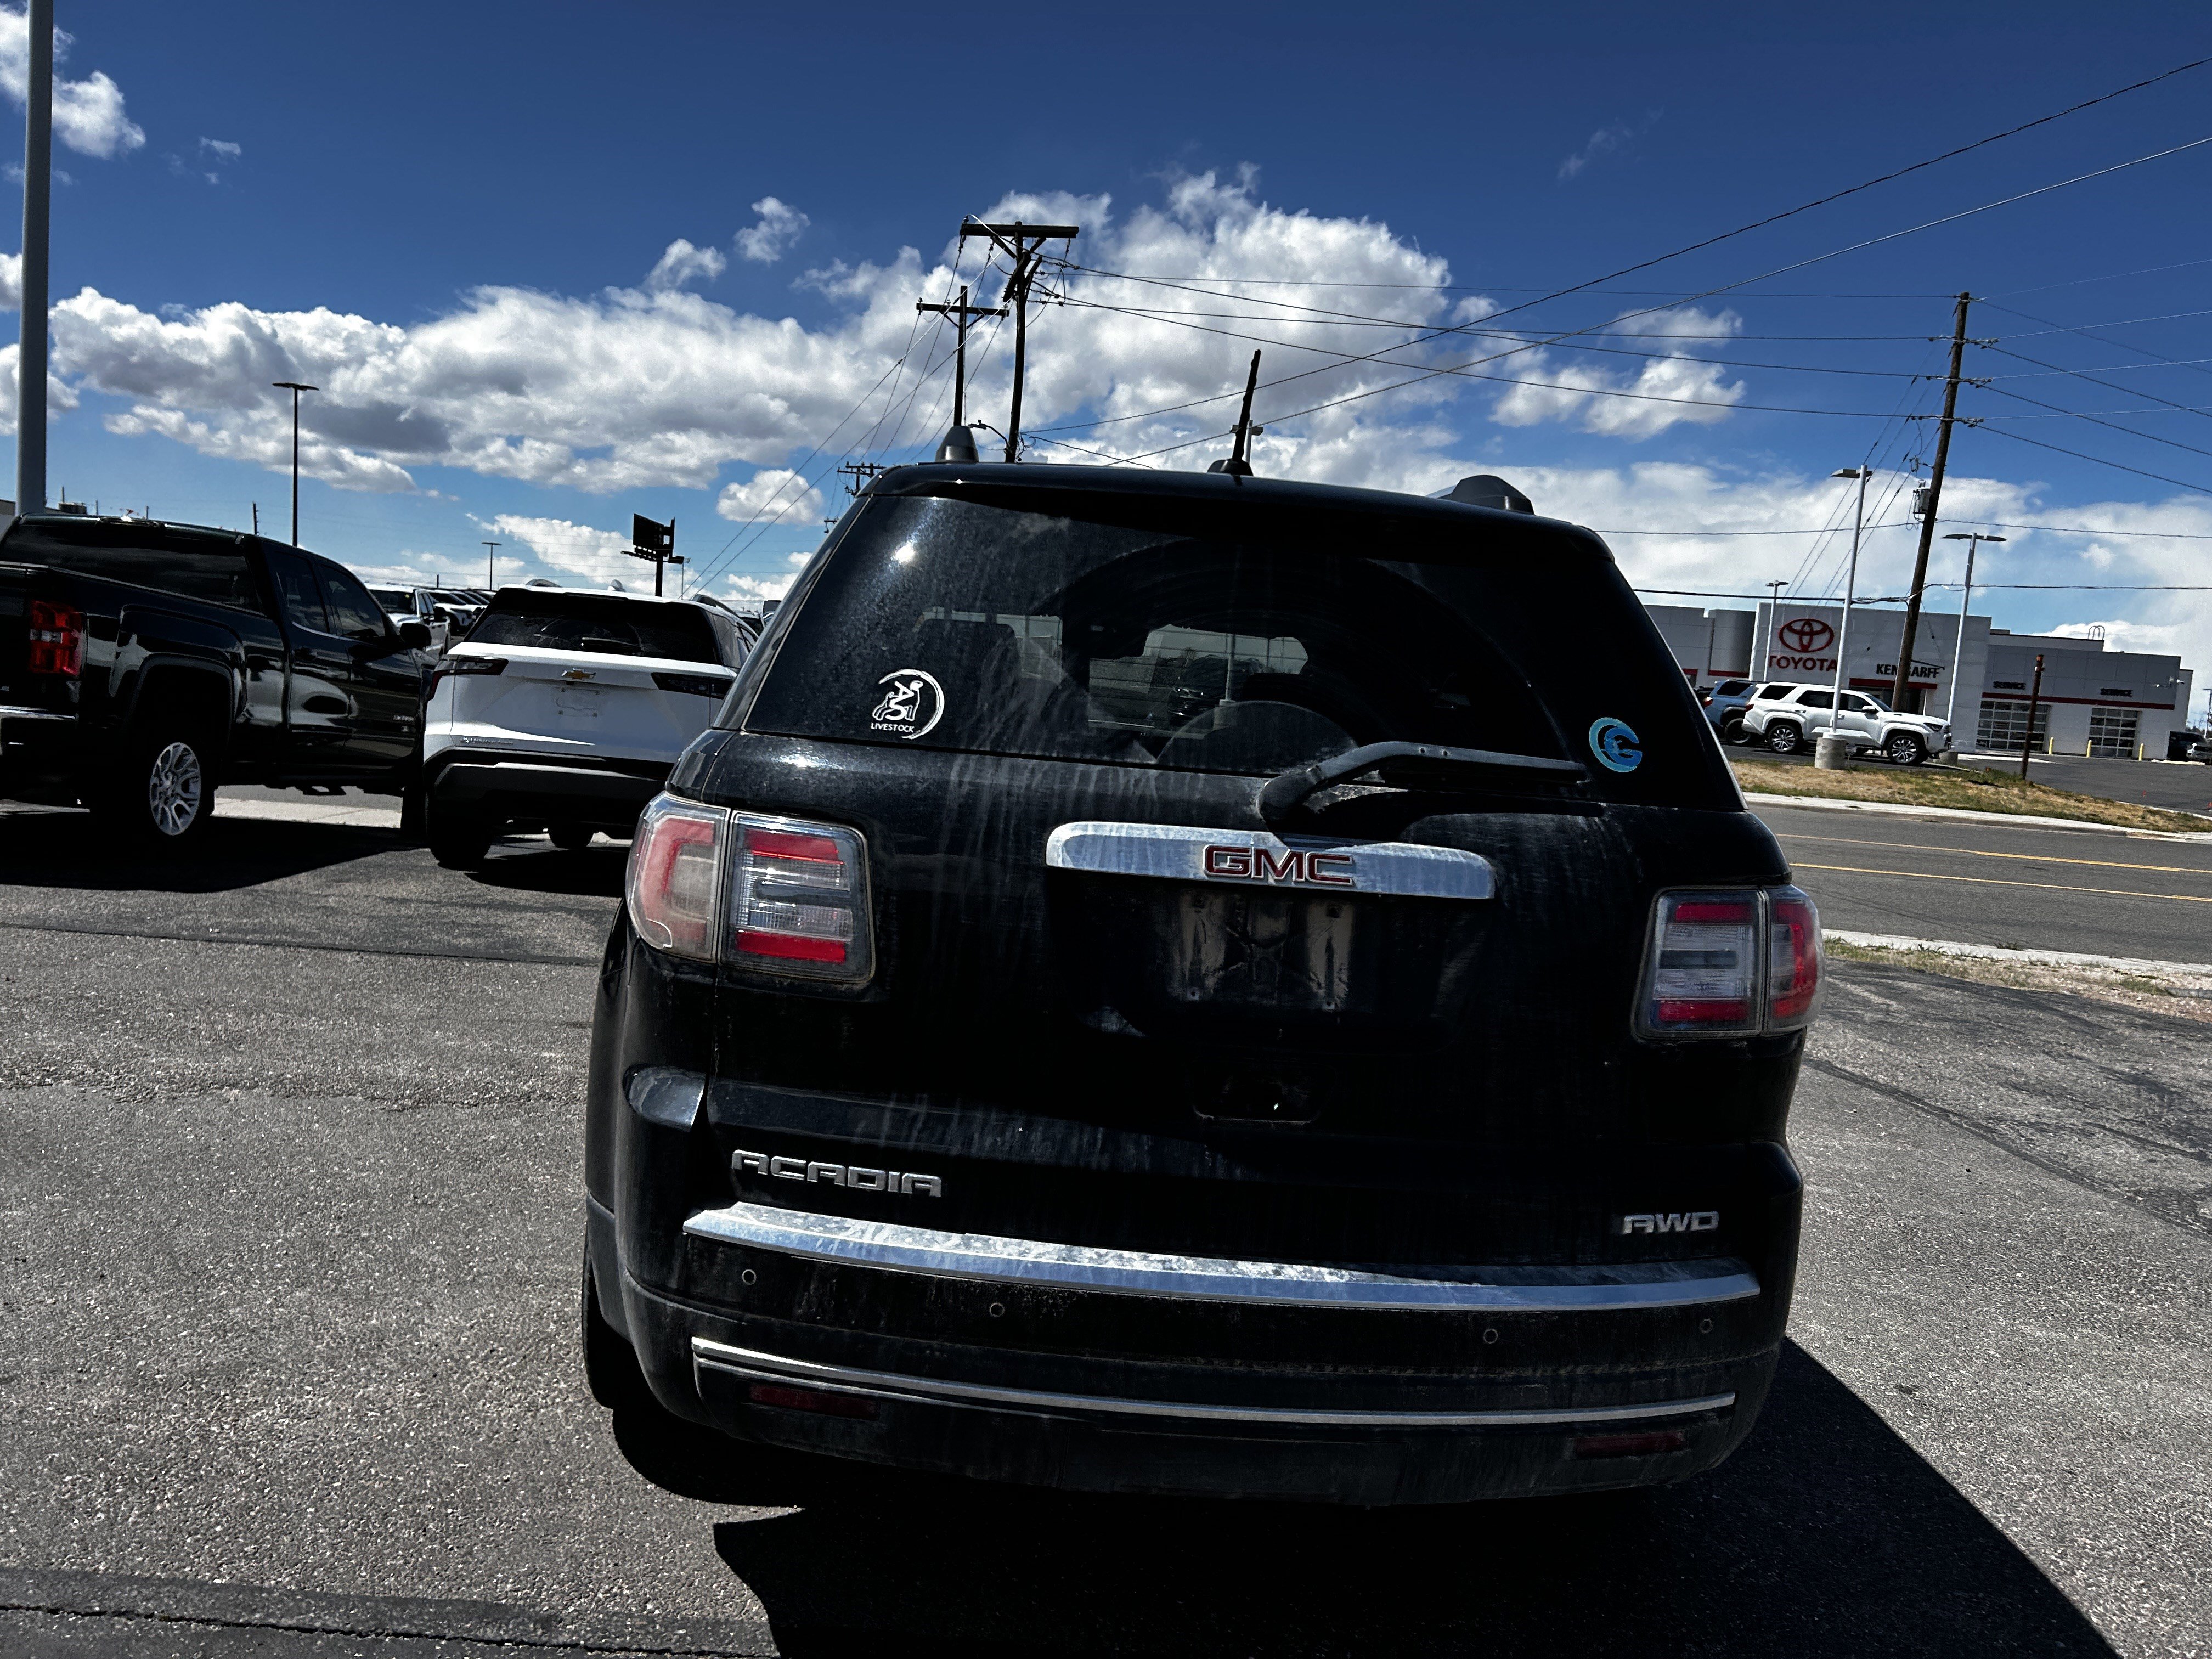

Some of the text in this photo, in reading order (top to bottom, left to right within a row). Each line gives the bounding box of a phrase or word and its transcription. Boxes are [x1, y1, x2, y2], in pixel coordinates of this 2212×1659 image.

[1768, 655, 1838, 672] TOYOTA
[1876, 663, 1940, 678] KEN ARFF
[871, 722, 915, 733] LIVESTOCK
[1202, 844, 1358, 887] GMC
[731, 1149, 942, 1198] ACADIA
[1623, 1211, 1719, 1234] AWD
